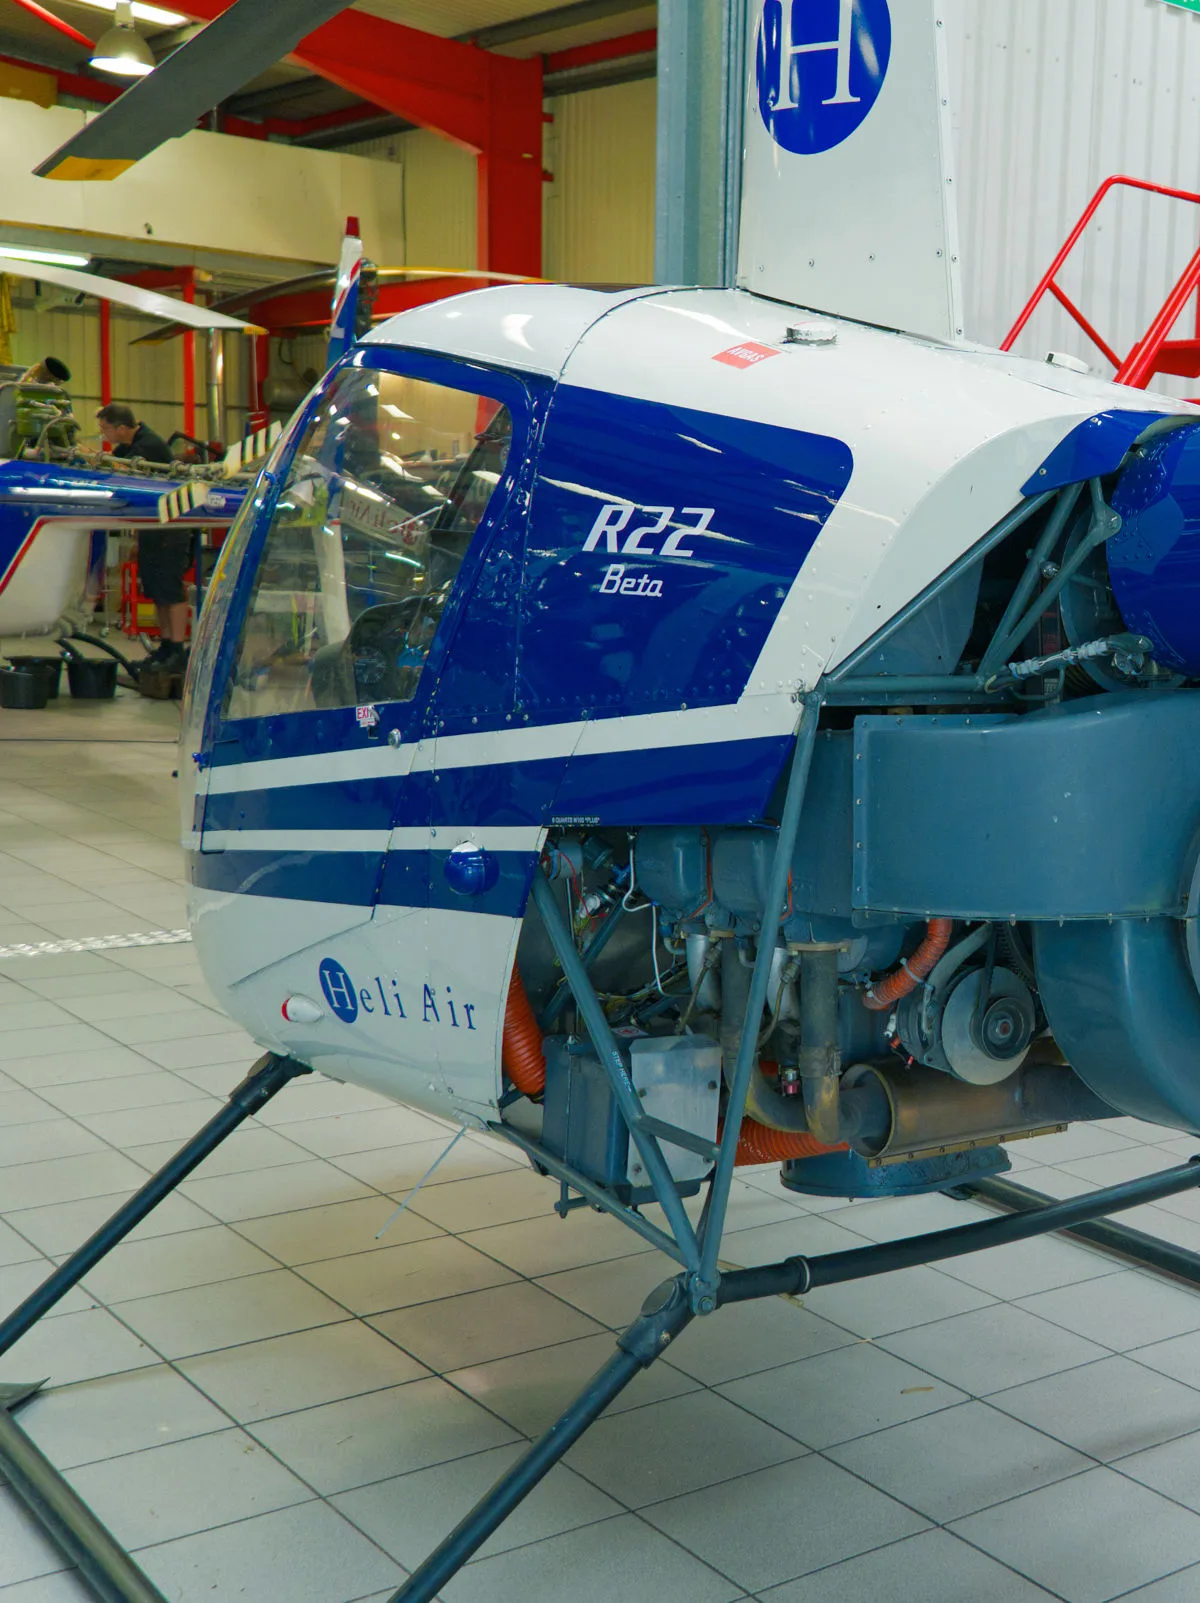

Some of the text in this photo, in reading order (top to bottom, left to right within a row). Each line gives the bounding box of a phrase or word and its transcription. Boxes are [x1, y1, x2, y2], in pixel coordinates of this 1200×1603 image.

[727, 346, 765, 363] AVGAS
[582, 504, 716, 557] R22
[599, 563, 664, 598] Beta
[320, 962, 477, 1031] Heli Air
